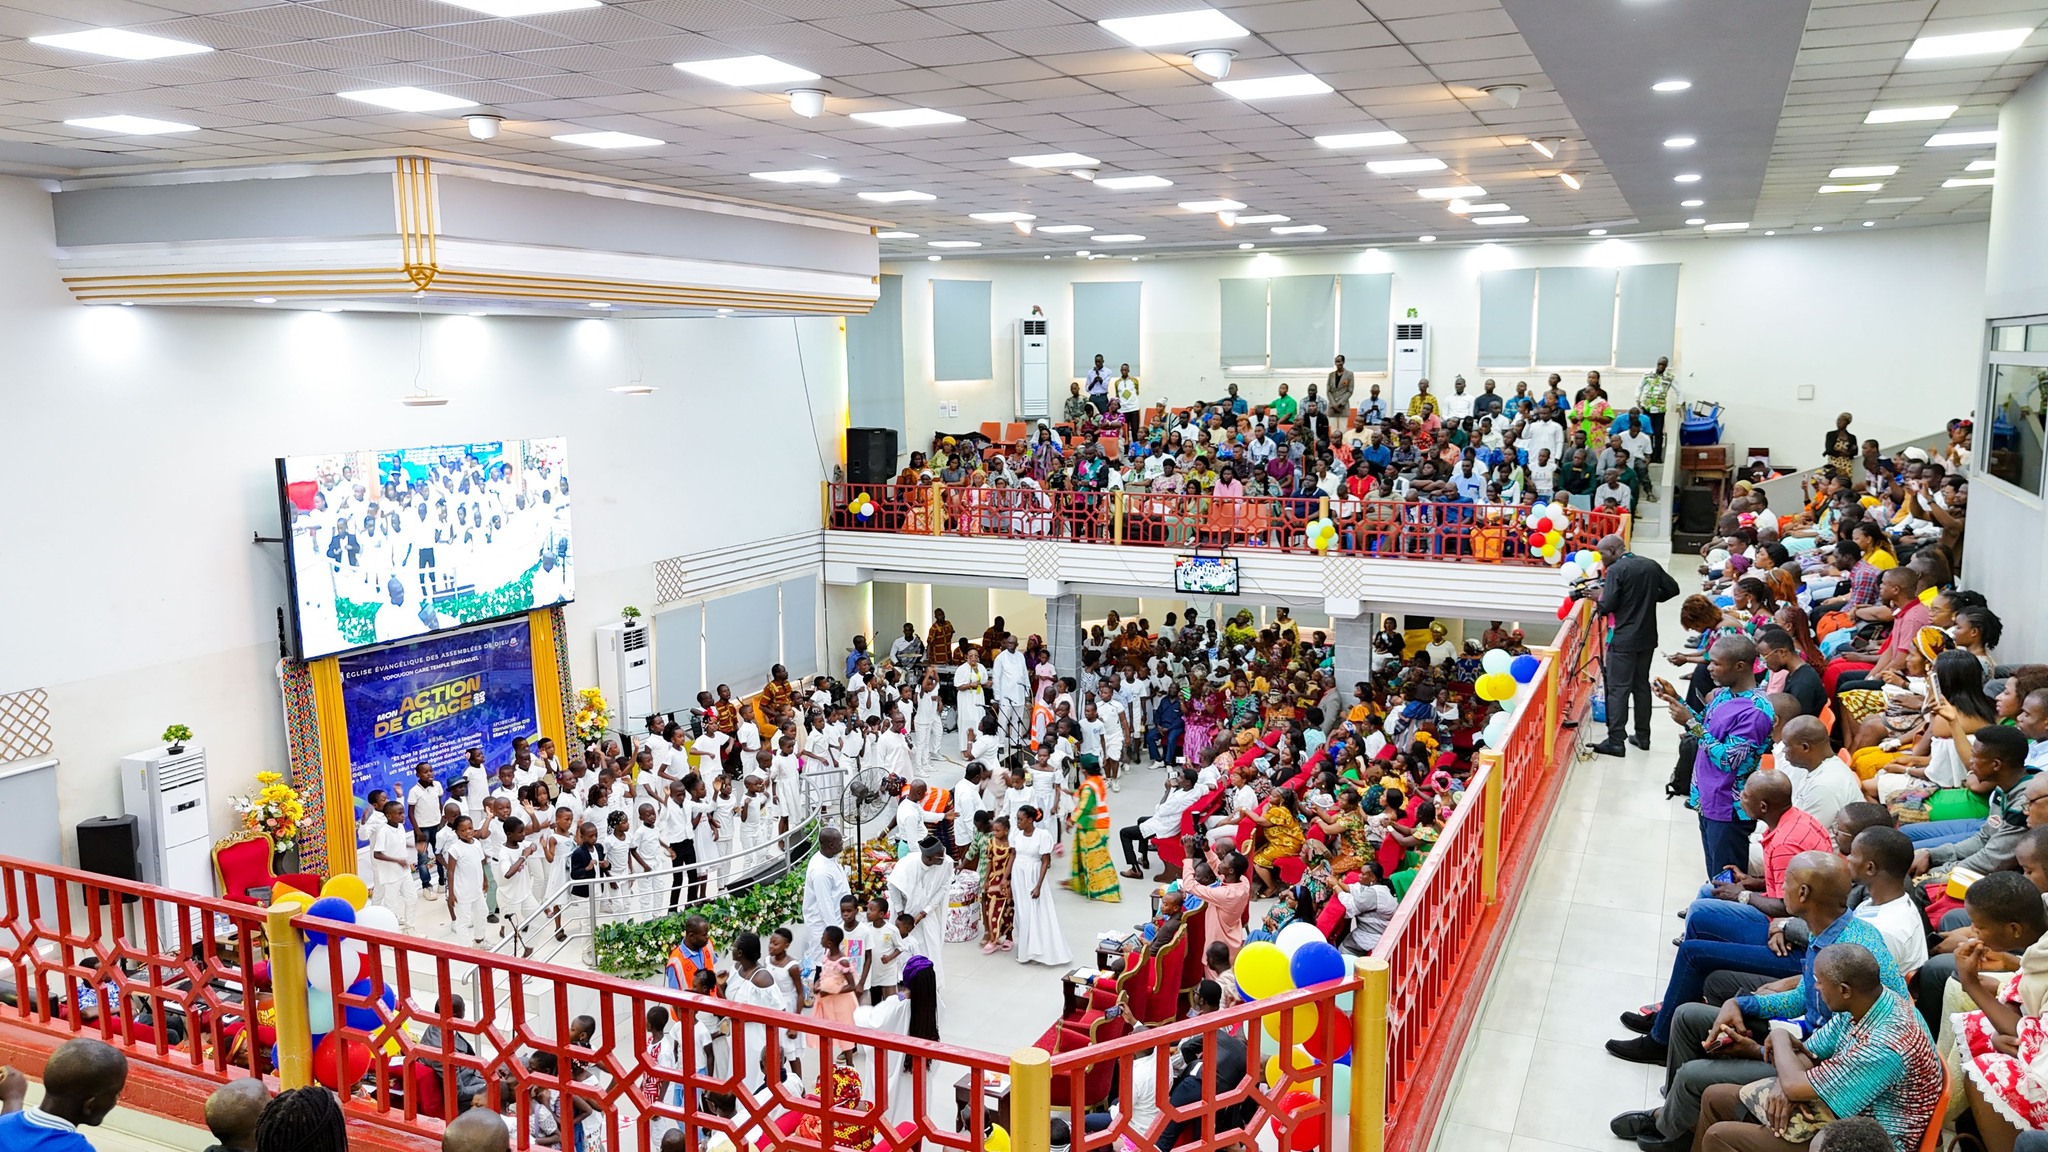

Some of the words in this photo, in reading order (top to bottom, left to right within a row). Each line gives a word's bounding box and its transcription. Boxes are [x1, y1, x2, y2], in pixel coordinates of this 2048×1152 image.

[346, 668, 372, 679] ÉGLISE
[375, 657, 424, 673] ÉVANGÉLIQUE
[425, 654, 439, 662] DES
[441, 644, 482, 658] ASSEMBLÉES
[382, 670, 414, 681] YOPOUGON
[414, 666, 430, 674] GARE
[430, 662, 450, 671] TEMPLE
[451, 655, 479, 666] EMMANUEL
[377, 709, 398, 722] MON
[400, 675, 481, 714] ACTION
[374, 716, 403, 739] DE
[407, 694, 473, 727] GRACE
[400, 752, 412, 760] que
[419, 746, 430, 755] paix
[461, 732, 482, 742] laquelle
[450, 743, 463, 752] pour
[398, 765, 410, 773] seul
